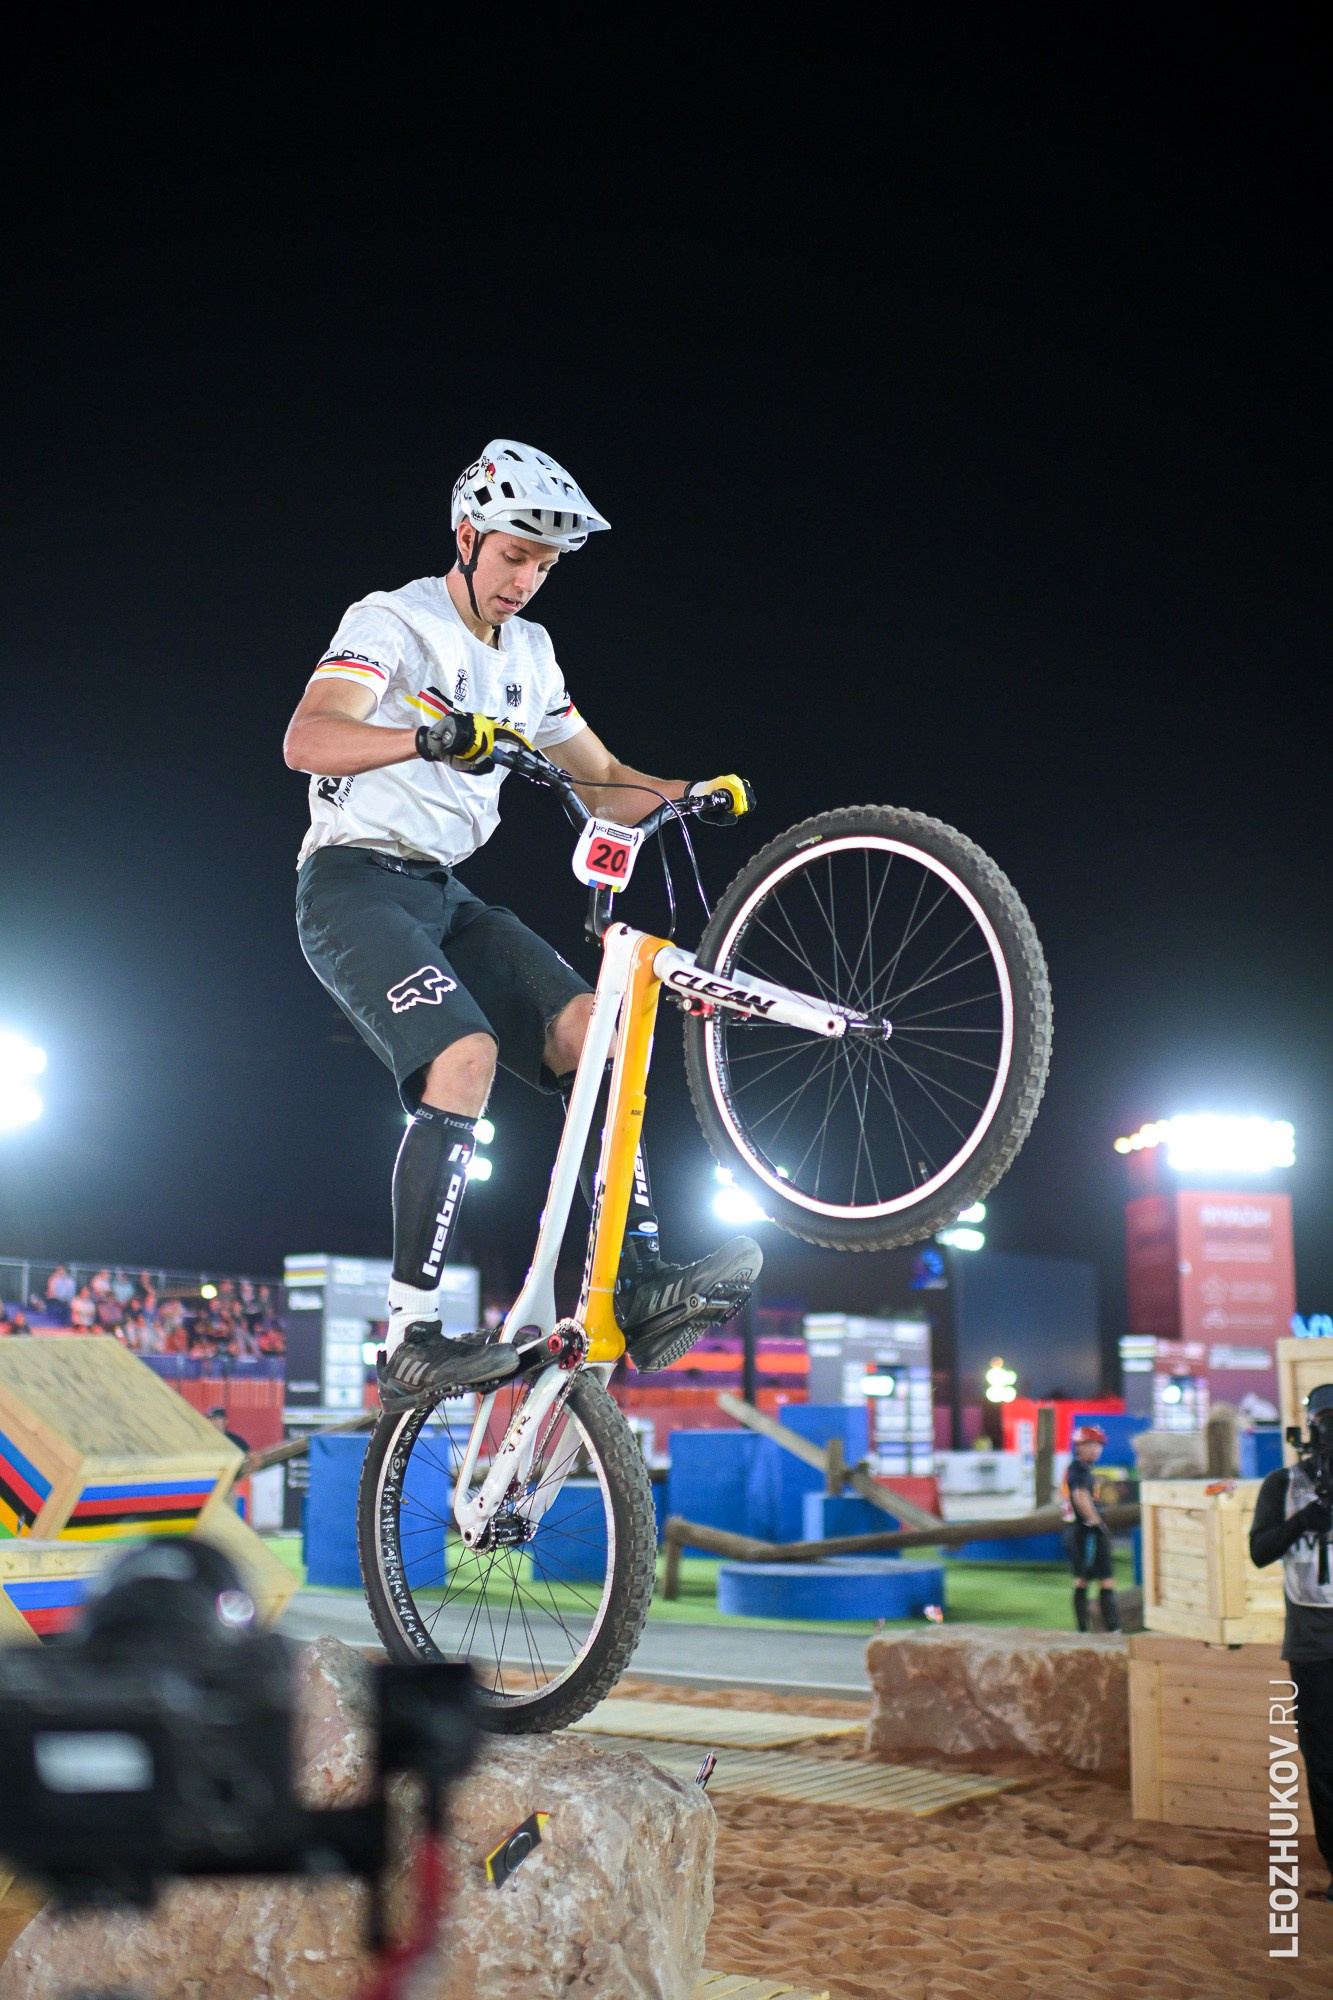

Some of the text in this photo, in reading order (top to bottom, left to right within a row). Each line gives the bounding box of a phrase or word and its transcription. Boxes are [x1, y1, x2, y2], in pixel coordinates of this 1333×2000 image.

[592, 843, 627, 873] 20
[669, 970, 777, 1015] CLEAN
[421, 1173, 462, 1278] hebo
